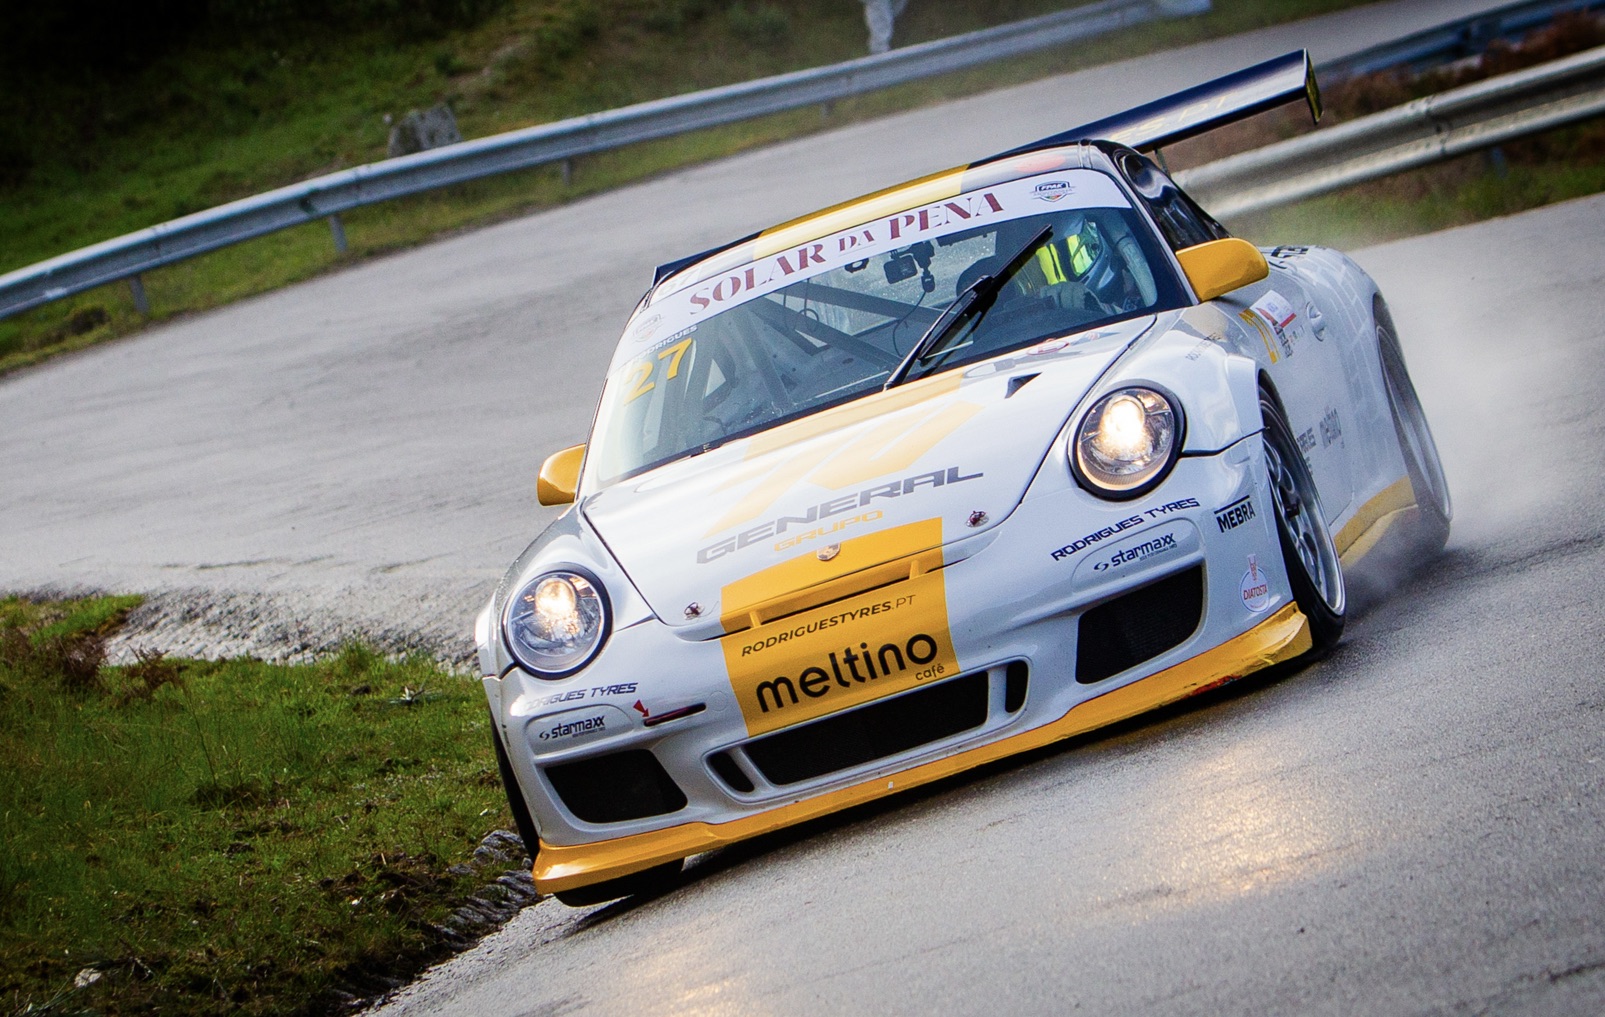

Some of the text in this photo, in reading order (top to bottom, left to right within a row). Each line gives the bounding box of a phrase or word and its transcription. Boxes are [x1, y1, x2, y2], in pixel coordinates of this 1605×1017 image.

[690, 192, 1005, 315] SOLAR DA PENA
[624, 337, 693, 406] 27
[696, 466, 984, 564] GENERAL
[773, 509, 884, 552] GRUPO
[1051, 515, 1145, 561] RODRIGUES
[1144, 498, 1200, 519] TYRES
[1216, 501, 1256, 533] MEBRA
[1110, 533, 1176, 567] starmaxx
[1243, 584, 1268, 600] DIATOSTA
[741, 594, 917, 657] RODRIGUESTYRES.PT
[591, 682, 639, 698] TYRES
[755, 633, 938, 713] meltino
[915, 662, 945, 681] café
[551, 715, 605, 739] starmaxx
